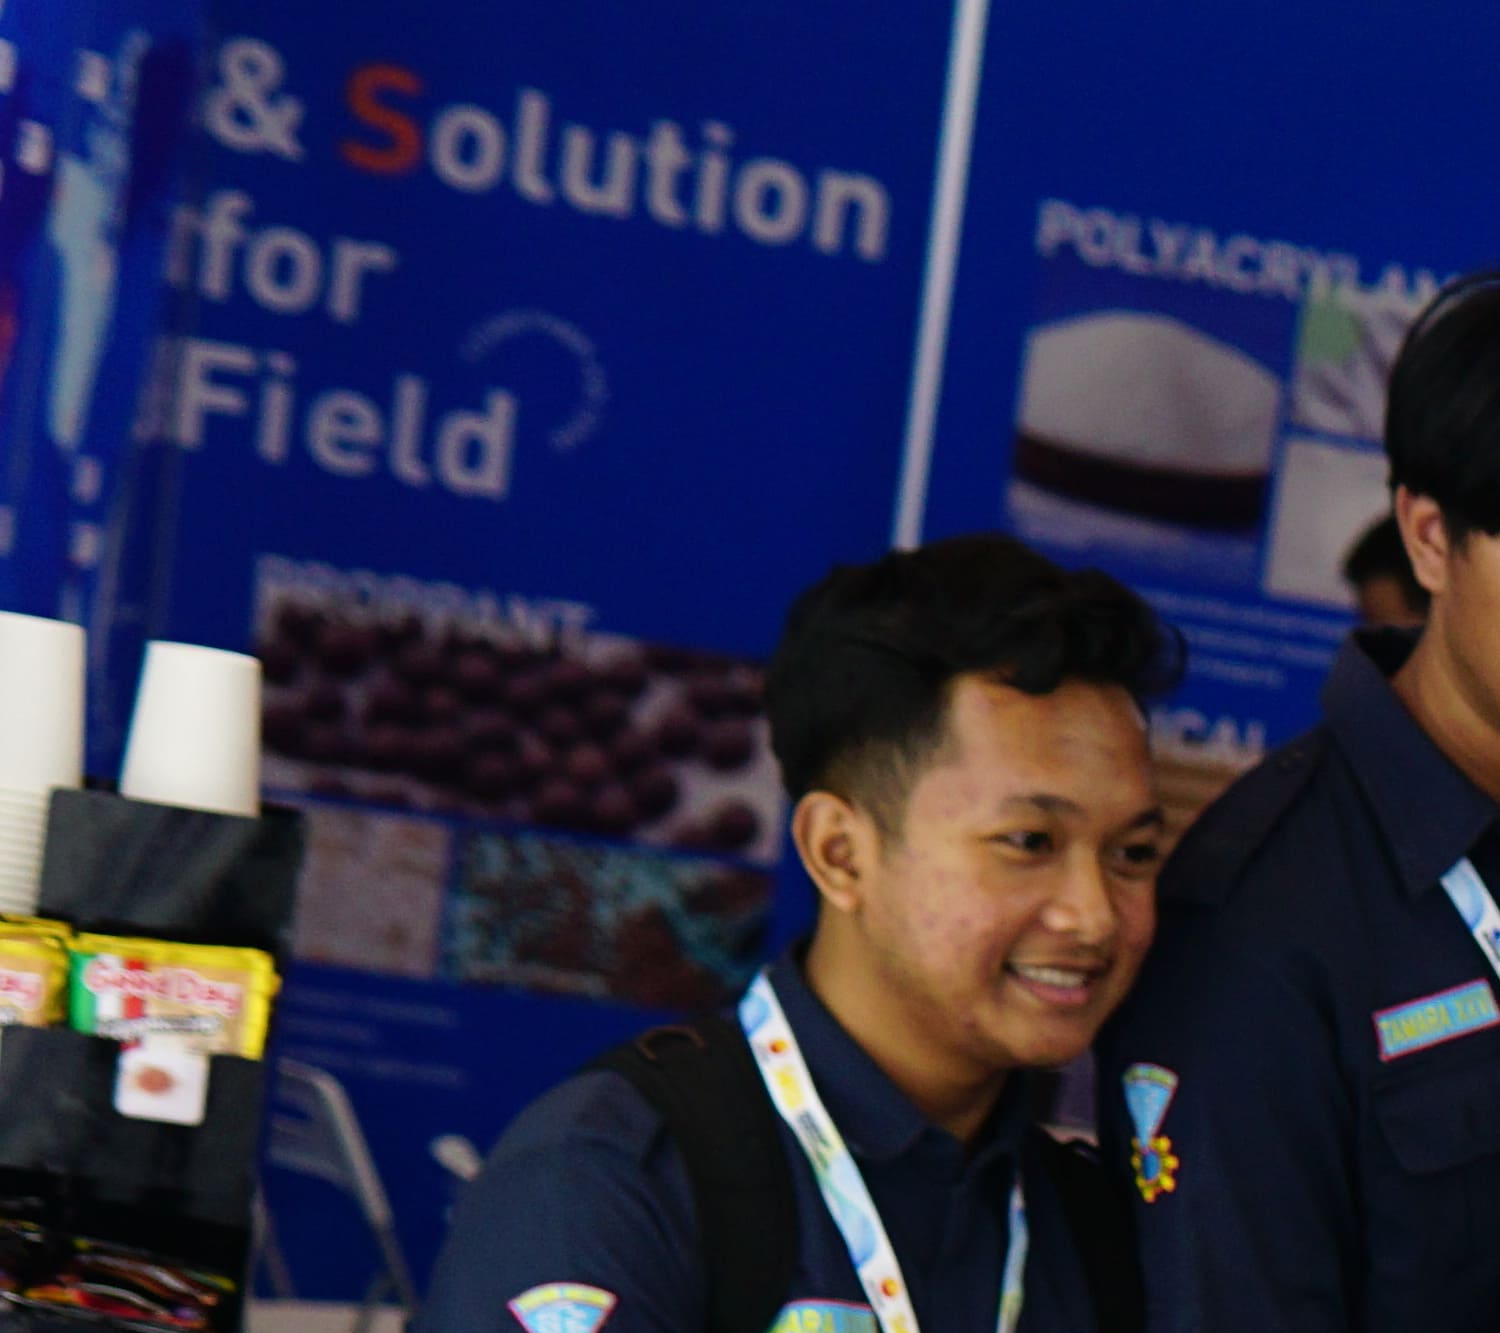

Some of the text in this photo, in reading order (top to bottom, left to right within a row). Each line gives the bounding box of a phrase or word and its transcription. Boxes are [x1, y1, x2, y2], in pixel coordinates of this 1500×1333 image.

[202, 36, 888, 261] & Solution
[195, 190, 396, 322] for
[177, 338, 517, 500] Field
